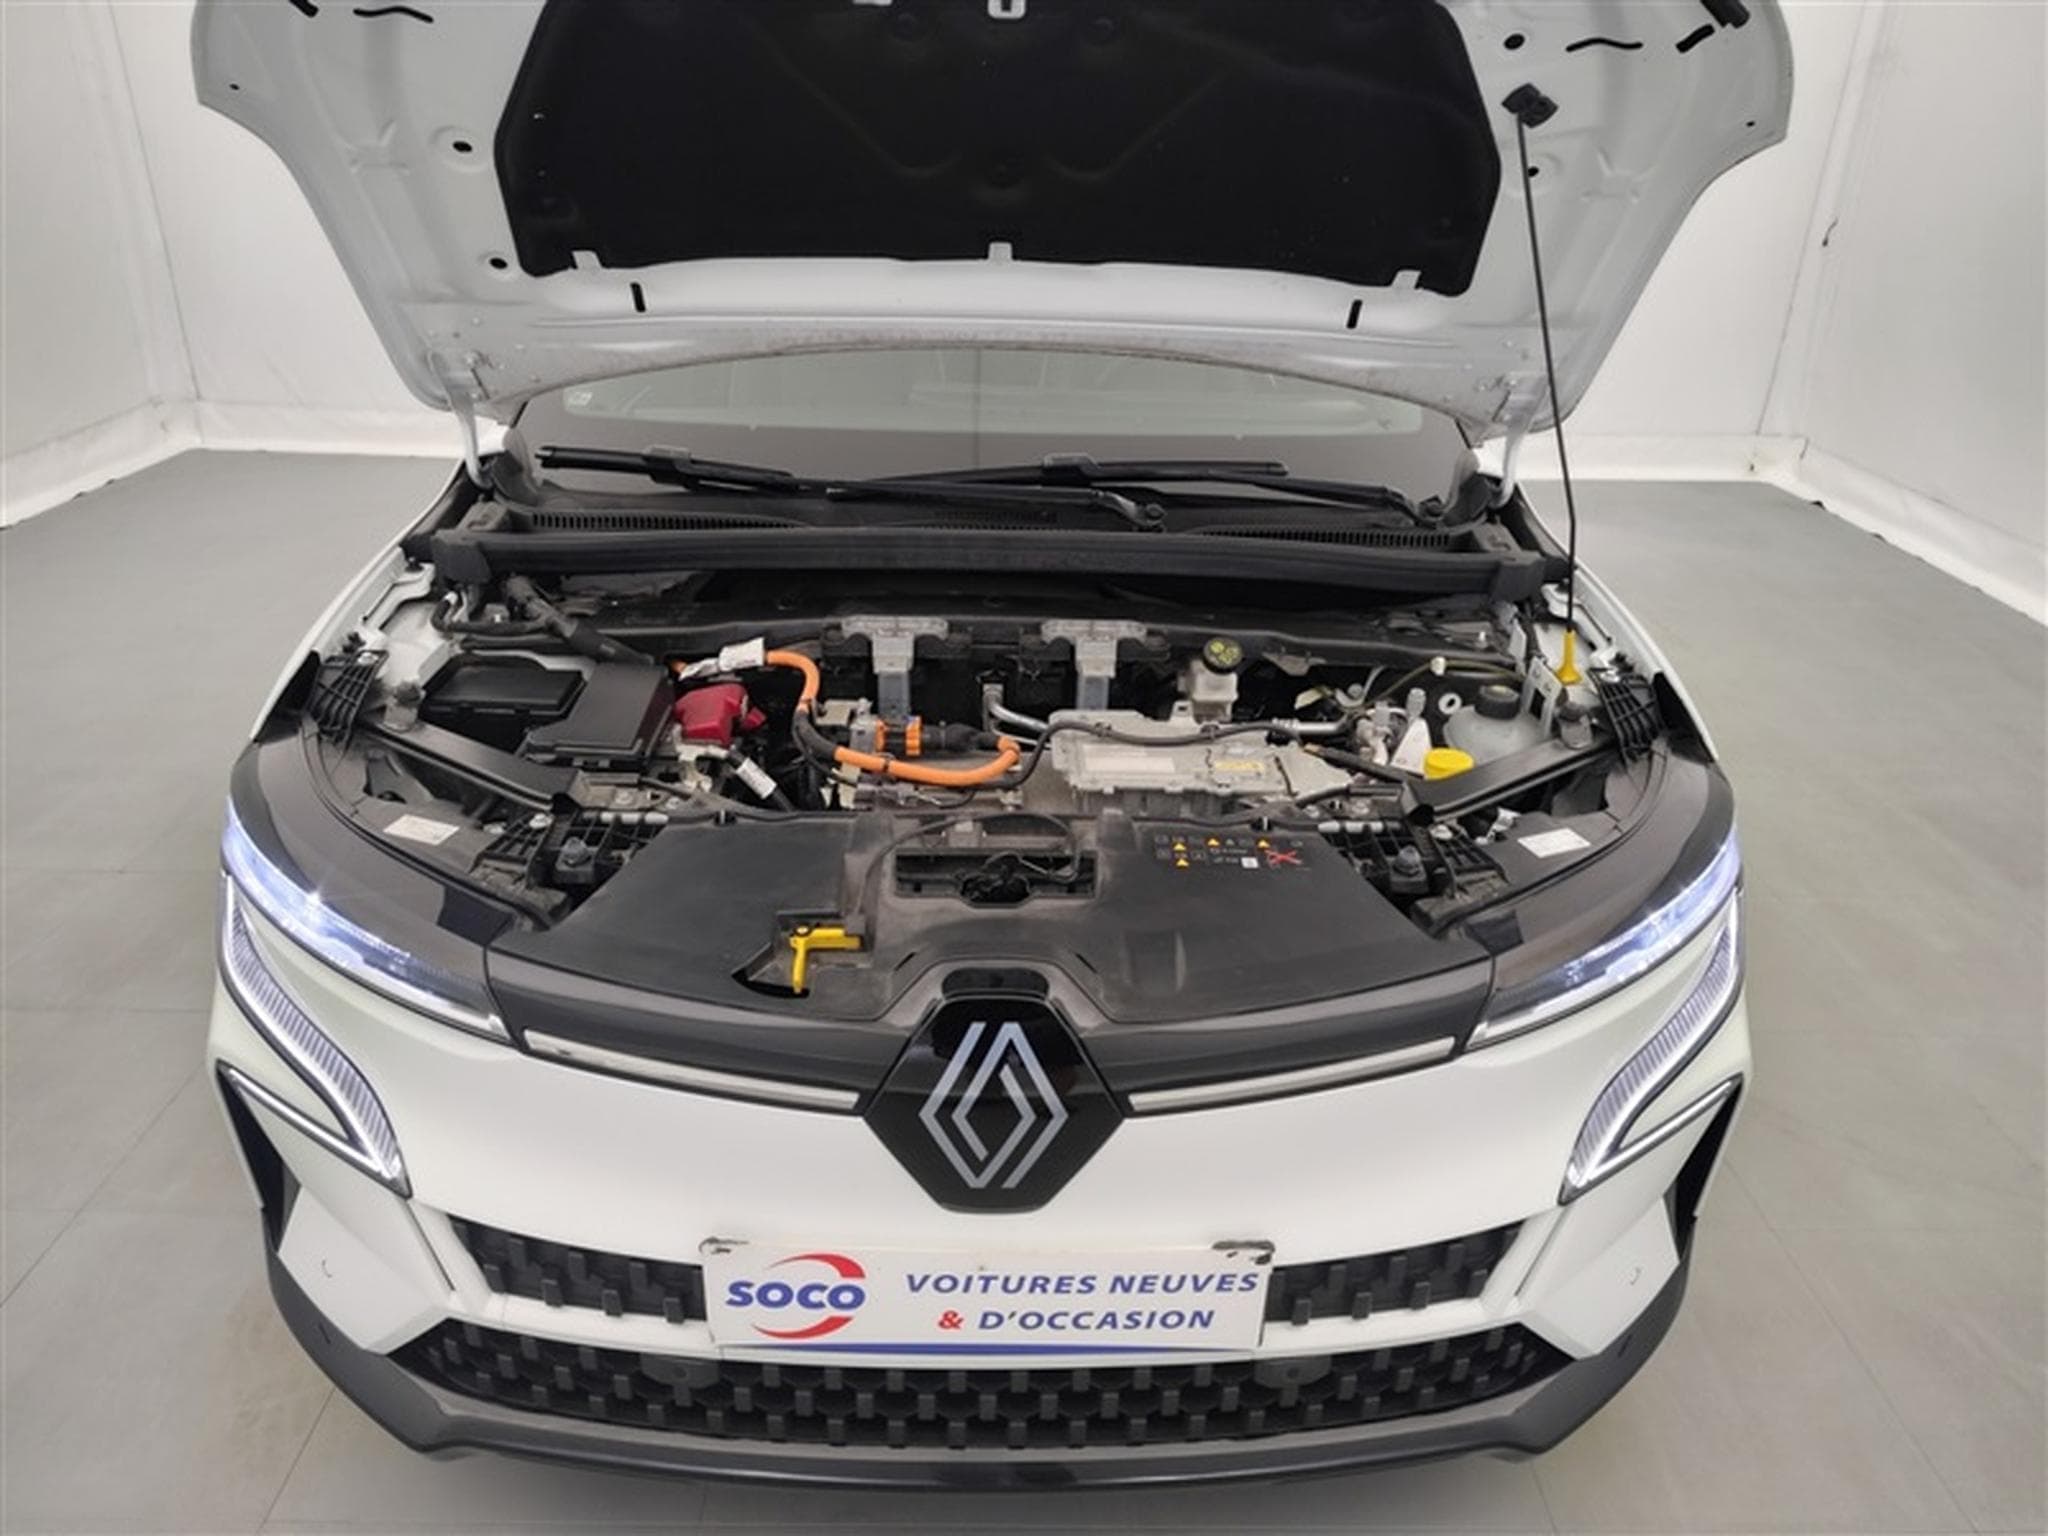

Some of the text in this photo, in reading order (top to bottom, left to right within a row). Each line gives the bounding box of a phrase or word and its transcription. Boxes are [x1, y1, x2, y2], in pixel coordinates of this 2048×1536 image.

[906, 1273, 1259, 1294] VOITURES NEUVES
[725, 1280, 866, 1311] SOCO
[938, 1310, 1214, 1330] & D'OCCASION
